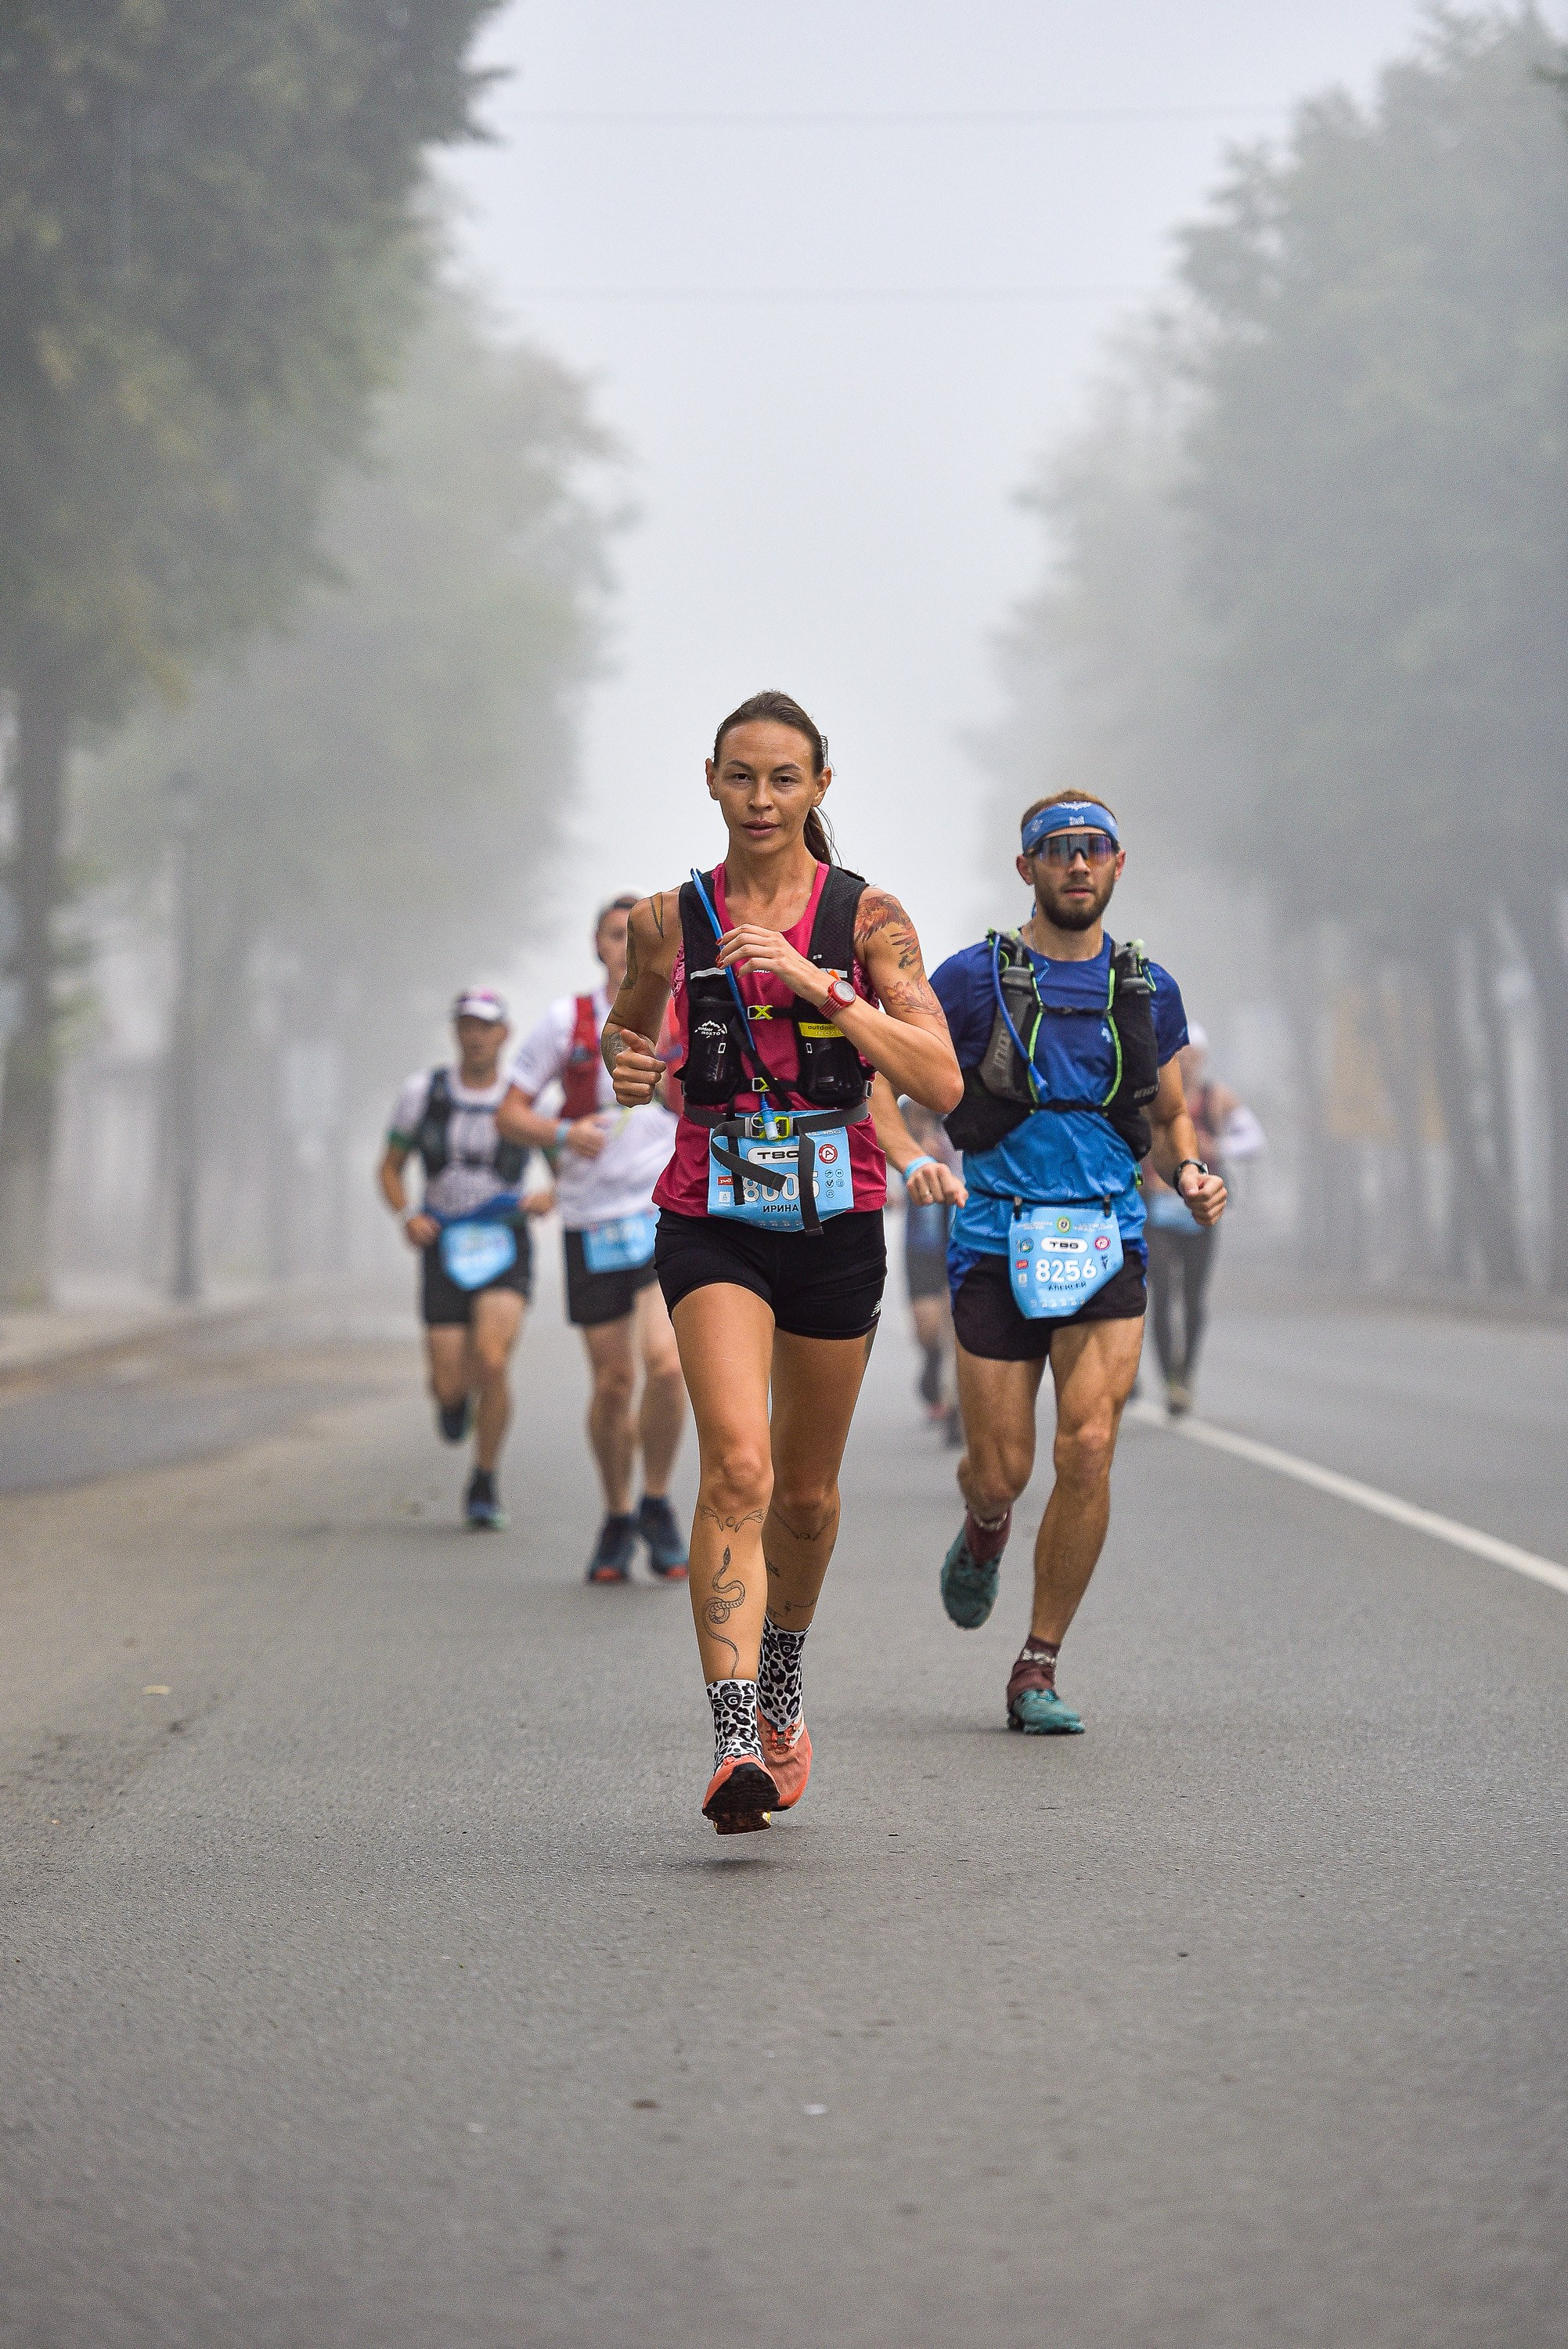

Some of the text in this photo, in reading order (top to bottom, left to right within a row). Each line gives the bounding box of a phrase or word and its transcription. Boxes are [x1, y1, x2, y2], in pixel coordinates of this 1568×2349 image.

[762, 1204, 798, 1213] ИРИНА
[1035, 1257, 1098, 1284] 8256
[728, 1696, 738, 1705] G
